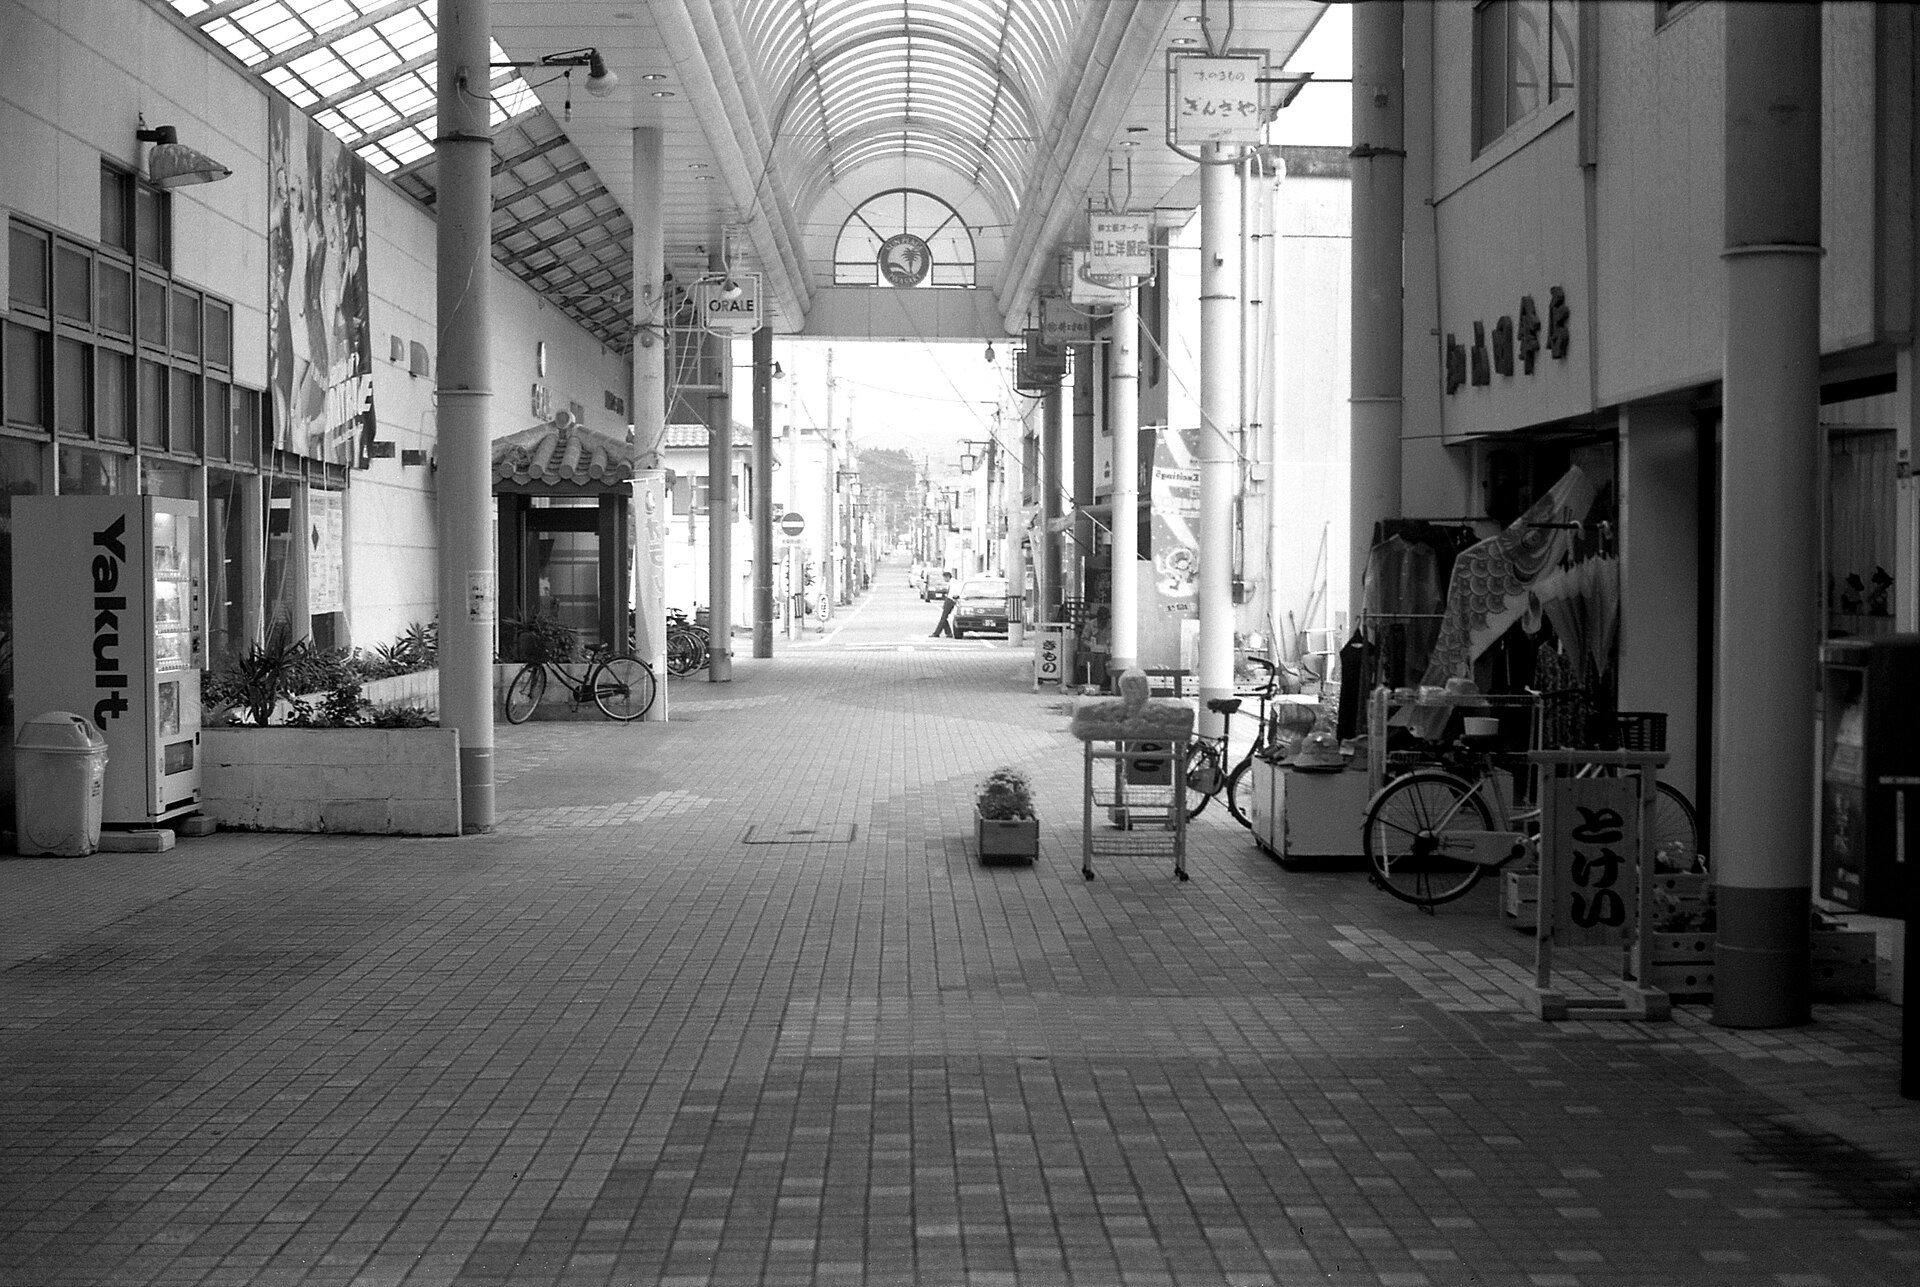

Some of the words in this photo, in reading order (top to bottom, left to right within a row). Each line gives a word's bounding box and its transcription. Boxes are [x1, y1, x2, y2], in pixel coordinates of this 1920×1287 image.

[1182, 96, 1257, 117] ぎんさや
[709, 299, 754, 312] ORALE
[92, 513, 128, 731] Yakult
[1042, 639, 1057, 674] きもの
[1570, 805, 1626, 929] とけい
